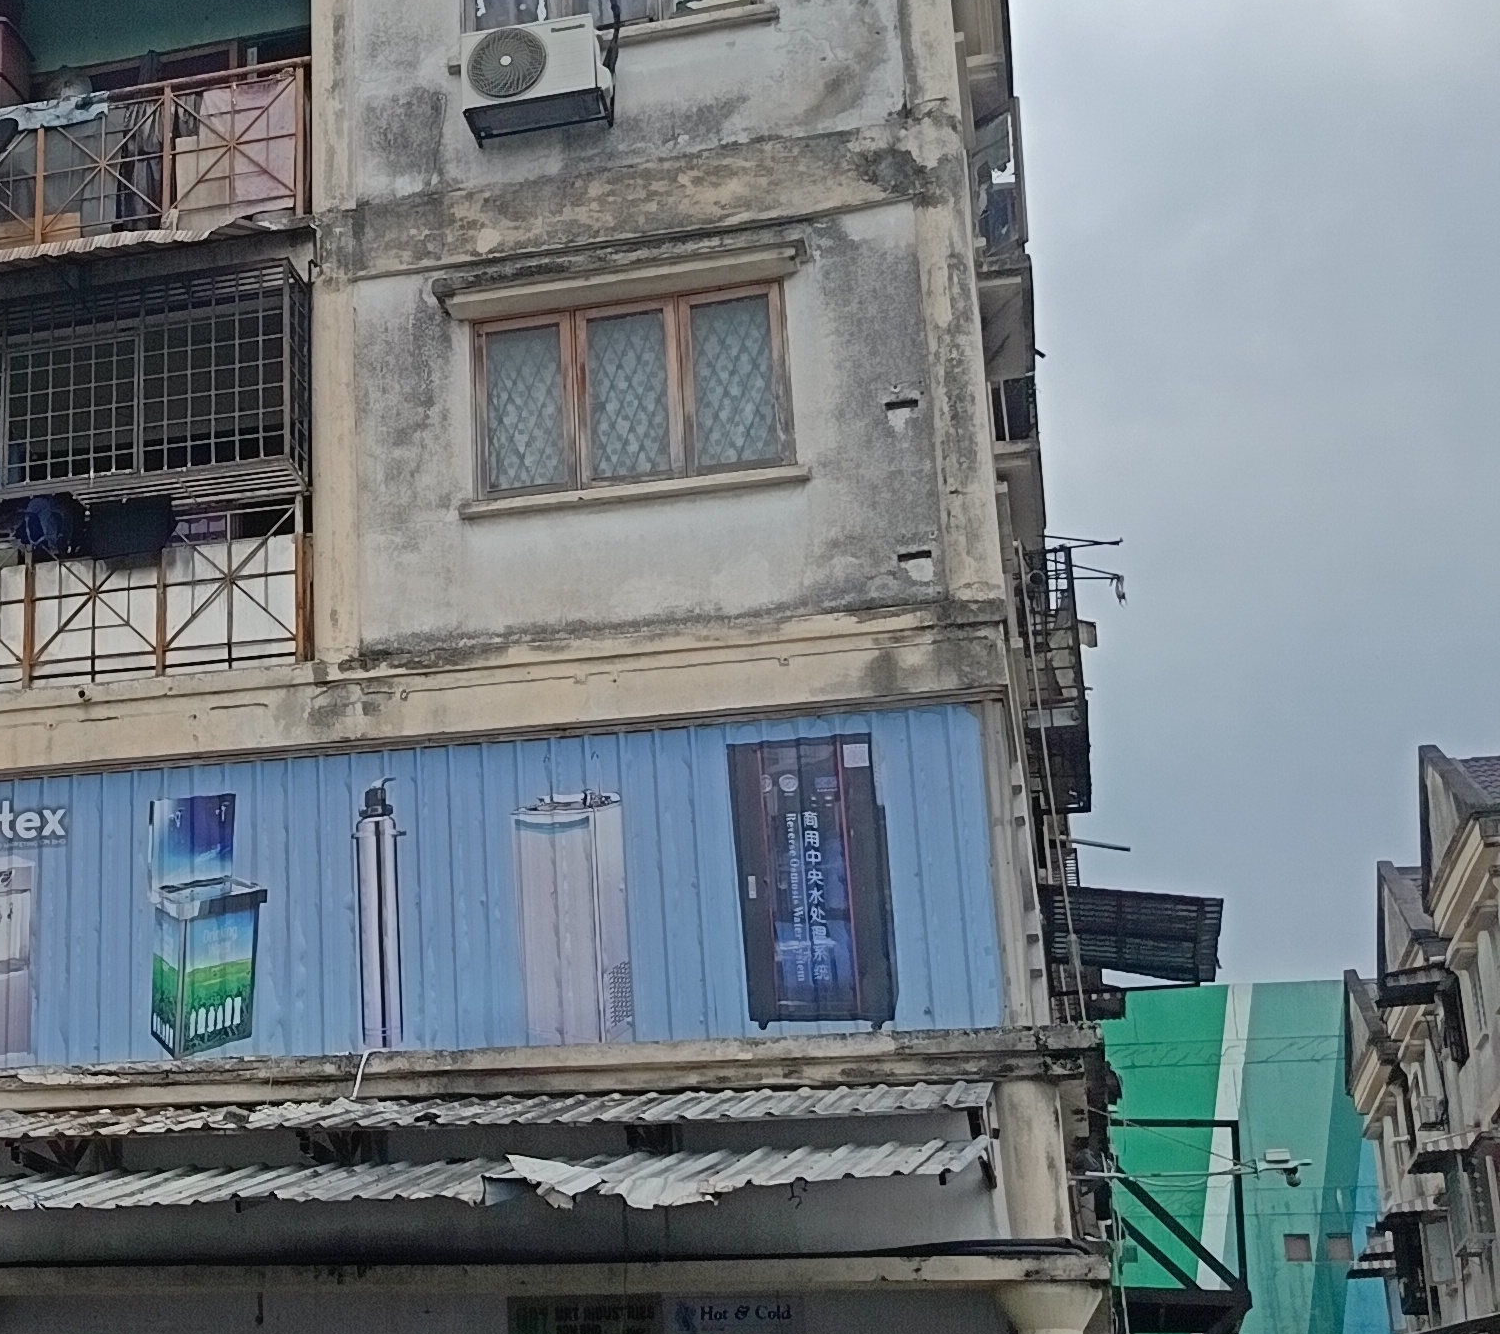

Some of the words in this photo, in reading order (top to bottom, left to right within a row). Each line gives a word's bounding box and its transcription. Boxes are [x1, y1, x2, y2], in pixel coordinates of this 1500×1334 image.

[785, 813, 798, 857] Reverse
[793, 906, 804, 940] Water
[700, 1305, 729, 1321] Hot
[734, 1305, 751, 1320] &
[755, 1304, 792, 1320] Cold
